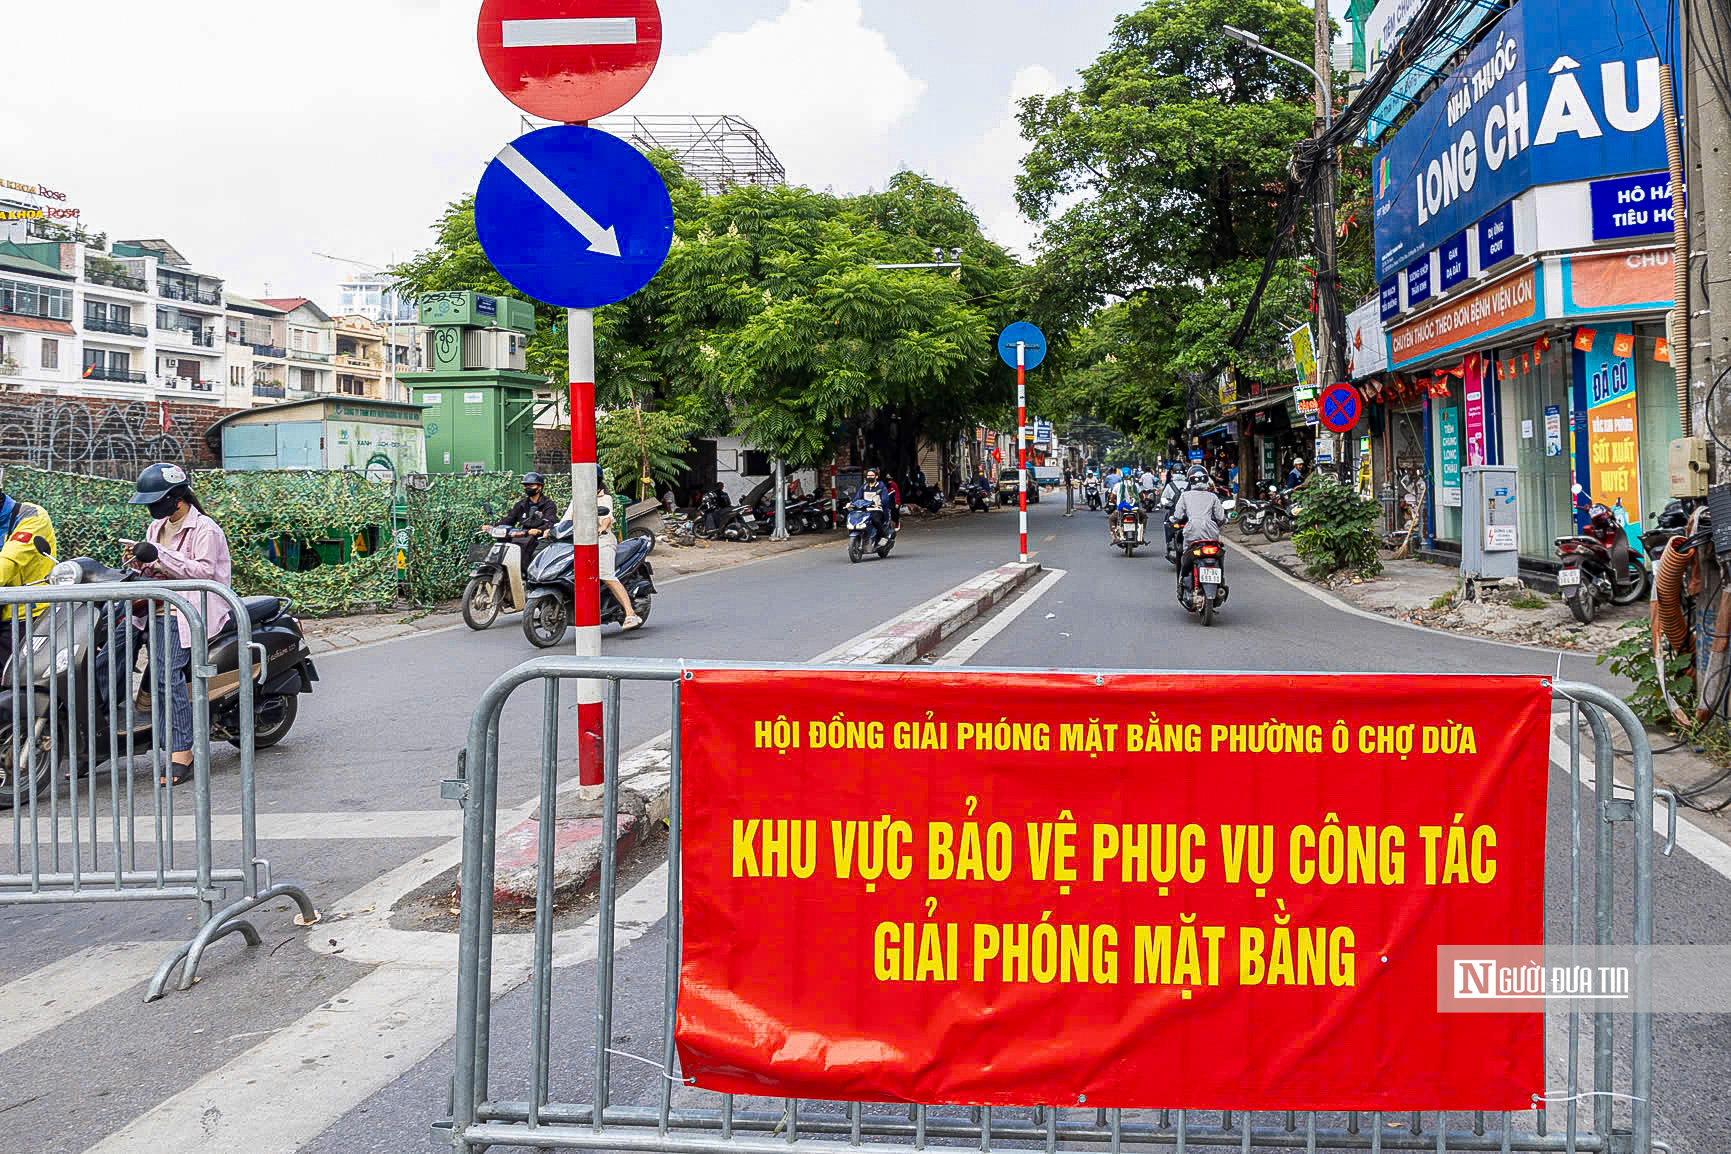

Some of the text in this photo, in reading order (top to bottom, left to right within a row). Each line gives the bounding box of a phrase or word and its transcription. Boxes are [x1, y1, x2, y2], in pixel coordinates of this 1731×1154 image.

[1447, 76, 1471, 127] NHÀ
[1472, 31, 1517, 103] THUỐC
[1416, 130, 1477, 227] LONG
[1484, 55, 1662, 171] CHÂU
[38, 184, 67, 201] Rose
[1617, 185, 1646, 204] HÔ
[8, 209, 44, 219] KHOA
[46, 205, 80, 219] Rose
[1612, 209, 1648, 227] TIÊU
[1448, 247, 1458, 260] GAN
[1490, 239, 1503, 254] GOUT
[1393, 279, 1532, 353] CHUYÊN THUỐC THEO ĐƠN BỆNH VIỆN LỚN
[1592, 357, 1628, 404] ĐÃ CÓ
[1592, 436, 1634, 464] SỐT XUẤT
[1600, 465, 1629, 493] HUYẾT
[754, 710, 1477, 761] HỘI ĐỒNG GIẢI PHÓNG MẶT BẰNG PHƯỜNG Ô CHỢ DỪA
[732, 795, 1497, 898] KHU VỰC BẢO VỆ PHỤC VỤ CÔNG TÁC
[873, 896, 1356, 1000] GIẢI PHÓNG MẶT BẰNG
